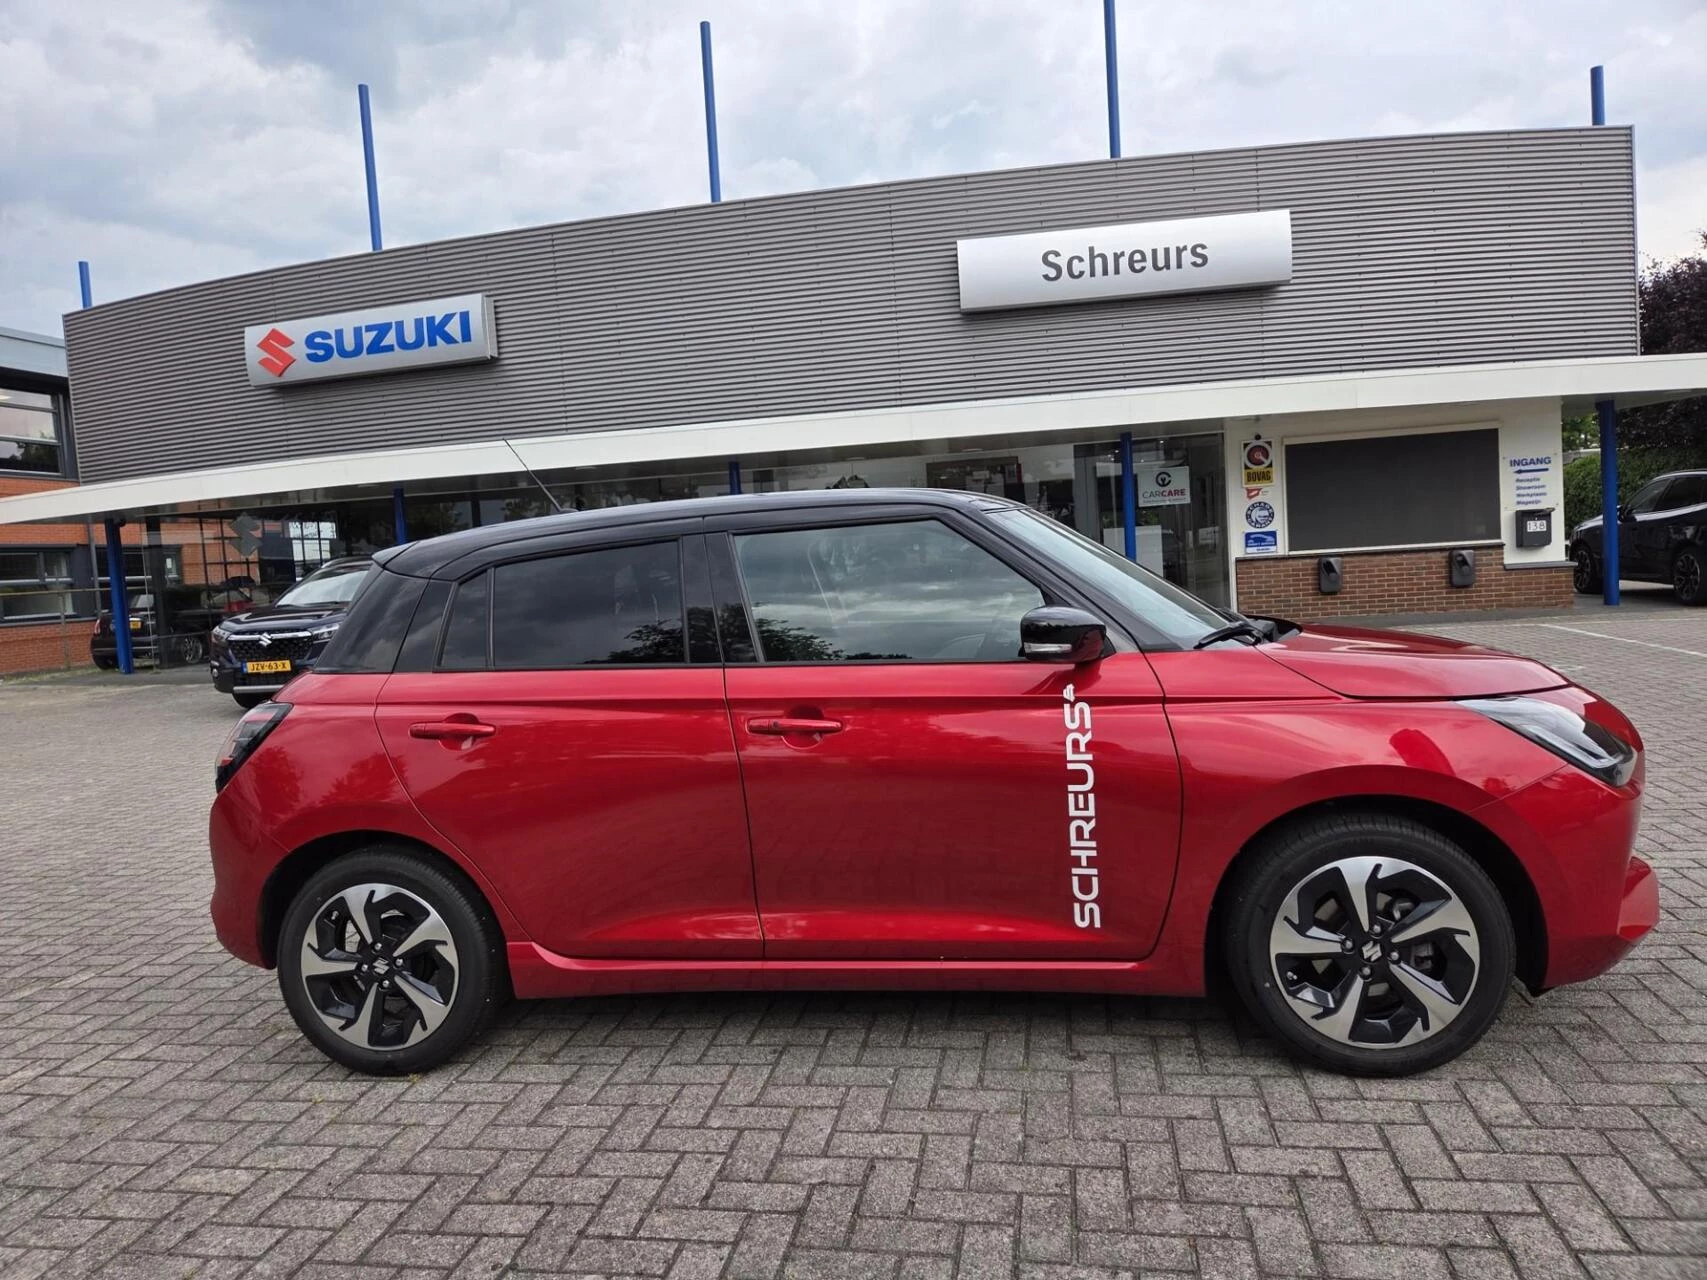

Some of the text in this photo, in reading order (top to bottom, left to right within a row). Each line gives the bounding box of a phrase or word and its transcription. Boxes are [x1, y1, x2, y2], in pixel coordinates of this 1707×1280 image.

[1041, 243, 1208, 282] Schreurs
[304, 310, 472, 363] SUZUKI
[1510, 456, 1551, 467] INGANG
[1246, 471, 1271, 482] BOVAG
[1142, 488, 1186, 499] CARCARE
[1527, 521, 1546, 531] 138
[1063, 701, 1101, 929] SCHREURS
